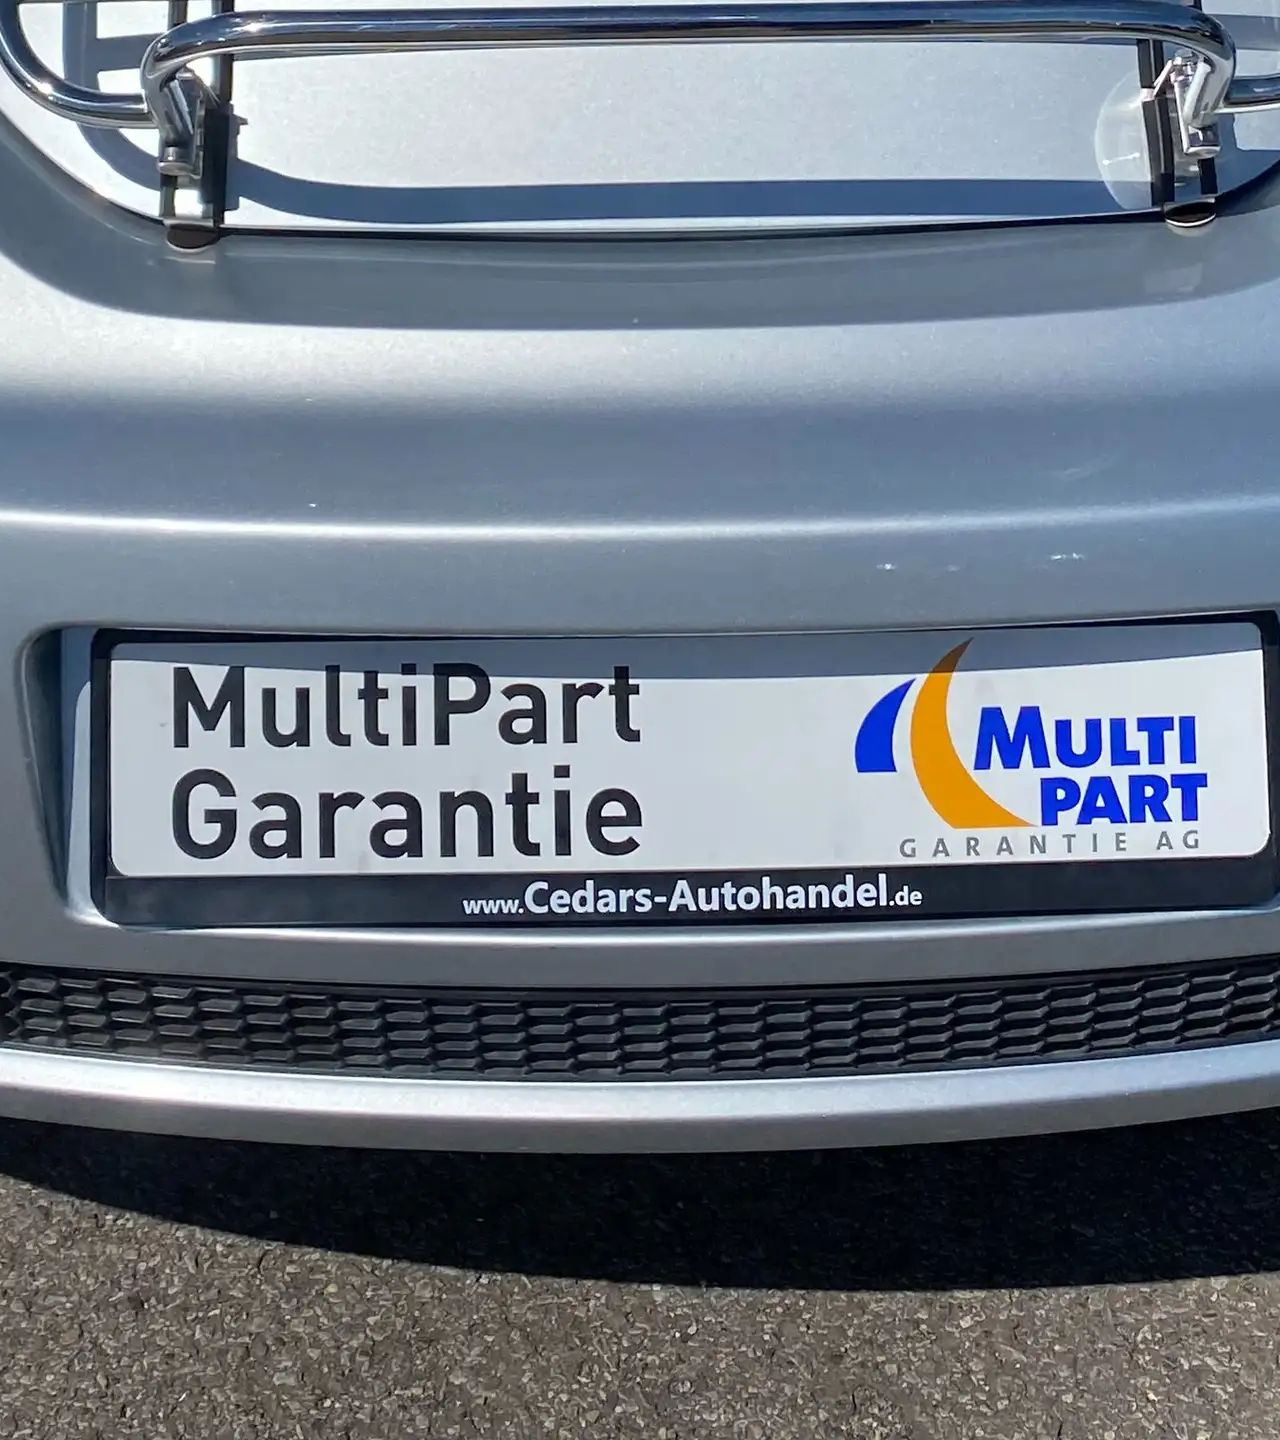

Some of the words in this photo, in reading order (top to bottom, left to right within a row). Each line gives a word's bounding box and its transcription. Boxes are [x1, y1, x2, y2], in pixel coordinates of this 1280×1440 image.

[173, 663, 642, 748] MultiPart
[974, 705, 1197, 769] MULTI
[172, 764, 642, 860] Garantie
[1040, 772, 1208, 827] PART
[899, 832, 1128, 859] GARANTIE
[1156, 829, 1201, 852] AG
[462, 873, 923, 918] www.Cedars-Autohandel.de
